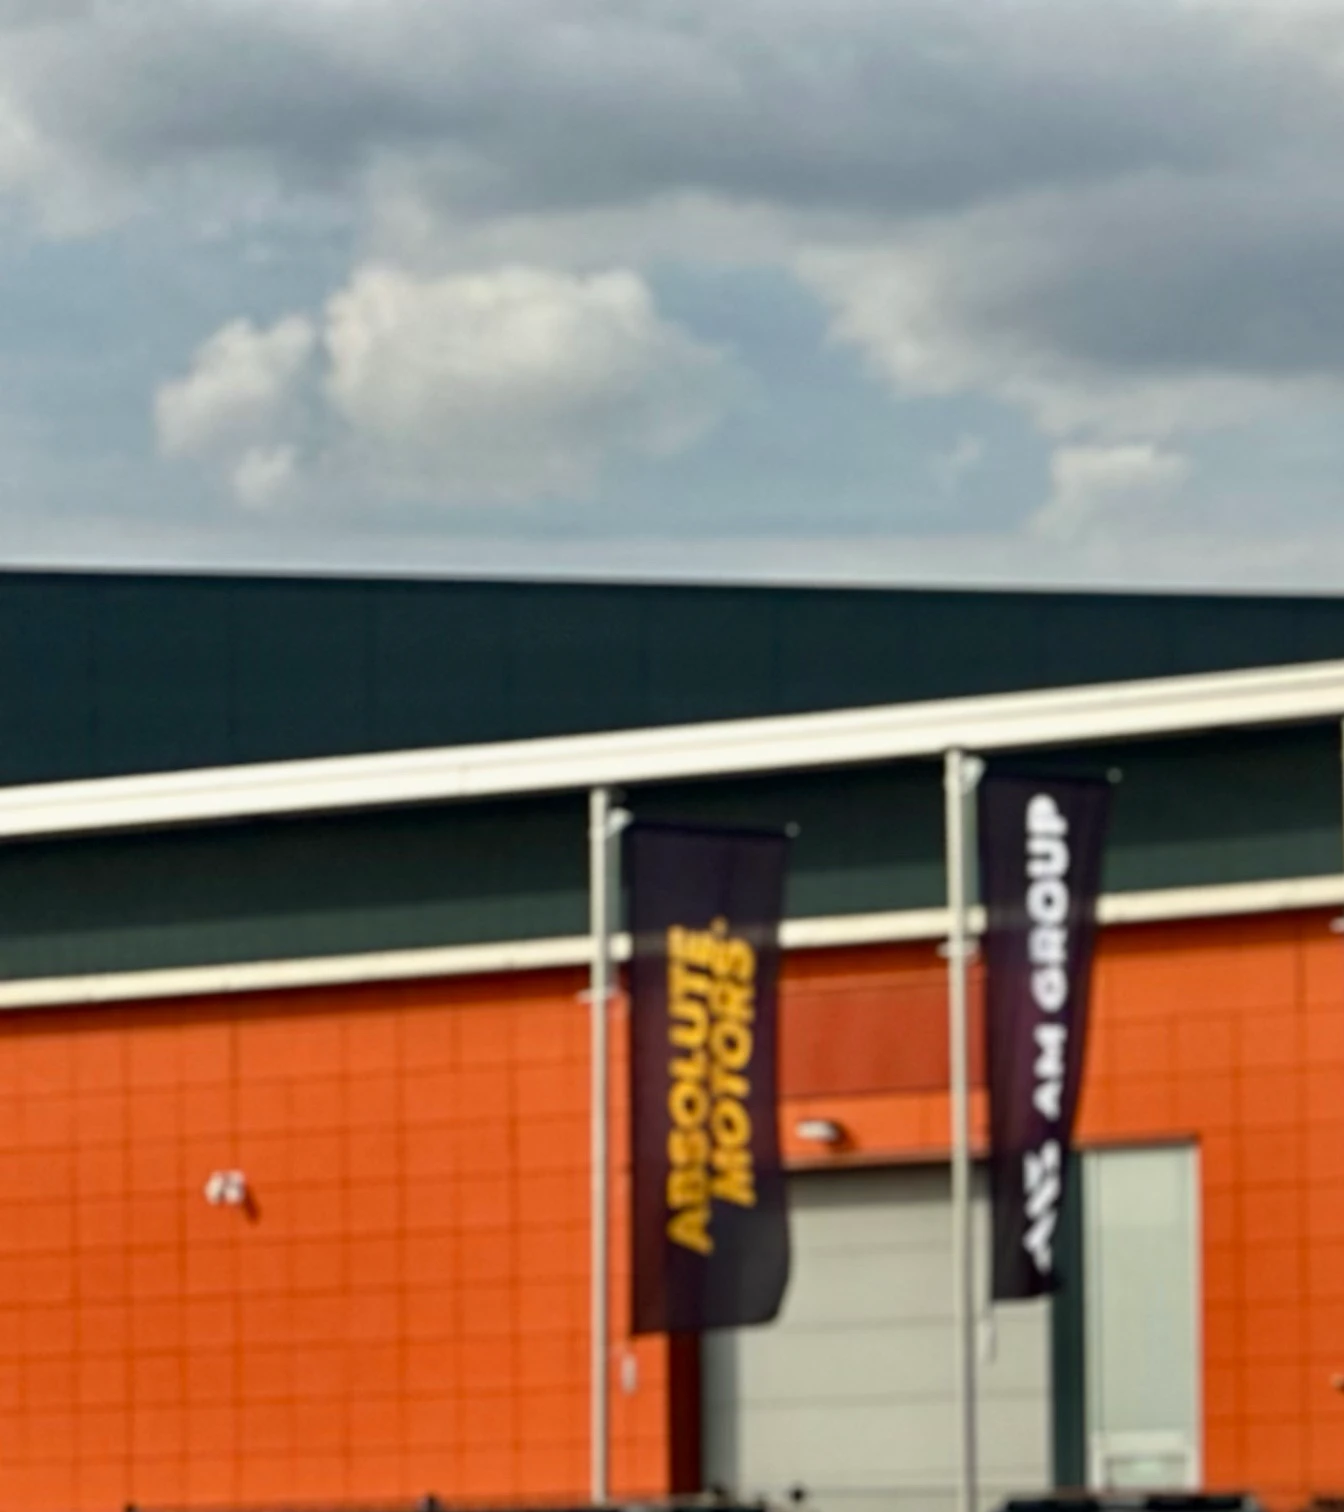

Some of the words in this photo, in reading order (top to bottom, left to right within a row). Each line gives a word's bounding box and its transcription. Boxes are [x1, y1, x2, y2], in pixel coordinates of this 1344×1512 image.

[1026, 793, 1070, 1014] GROUP
[667, 923, 713, 1256] ABSOLUTE
[709, 935, 756, 1208] MOTORS
